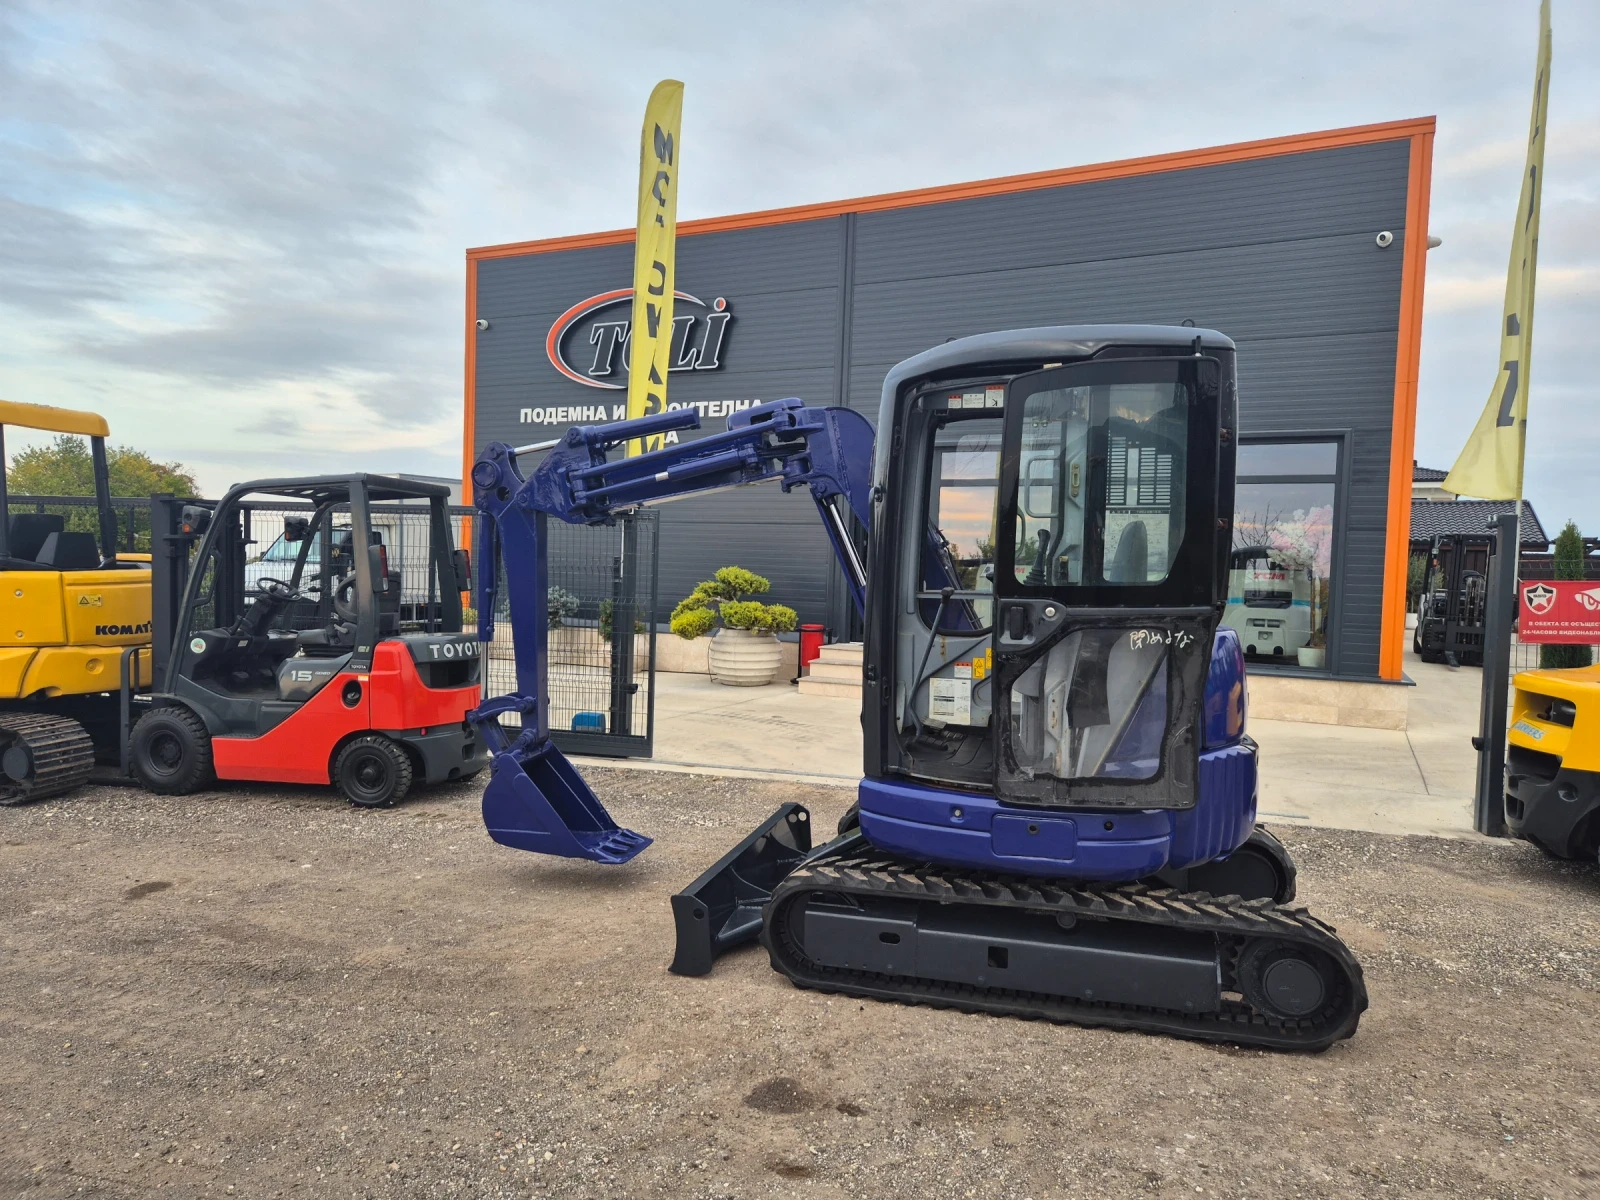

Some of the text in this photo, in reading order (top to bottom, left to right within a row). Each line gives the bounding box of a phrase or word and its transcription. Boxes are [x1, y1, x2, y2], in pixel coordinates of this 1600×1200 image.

[588, 297, 730, 375] TLi
[520, 405, 608, 425] ПОДЕМНА
[612, 404, 626, 420] И
[95, 621, 152, 636] KOMAT
[291, 670, 313, 682] 15
